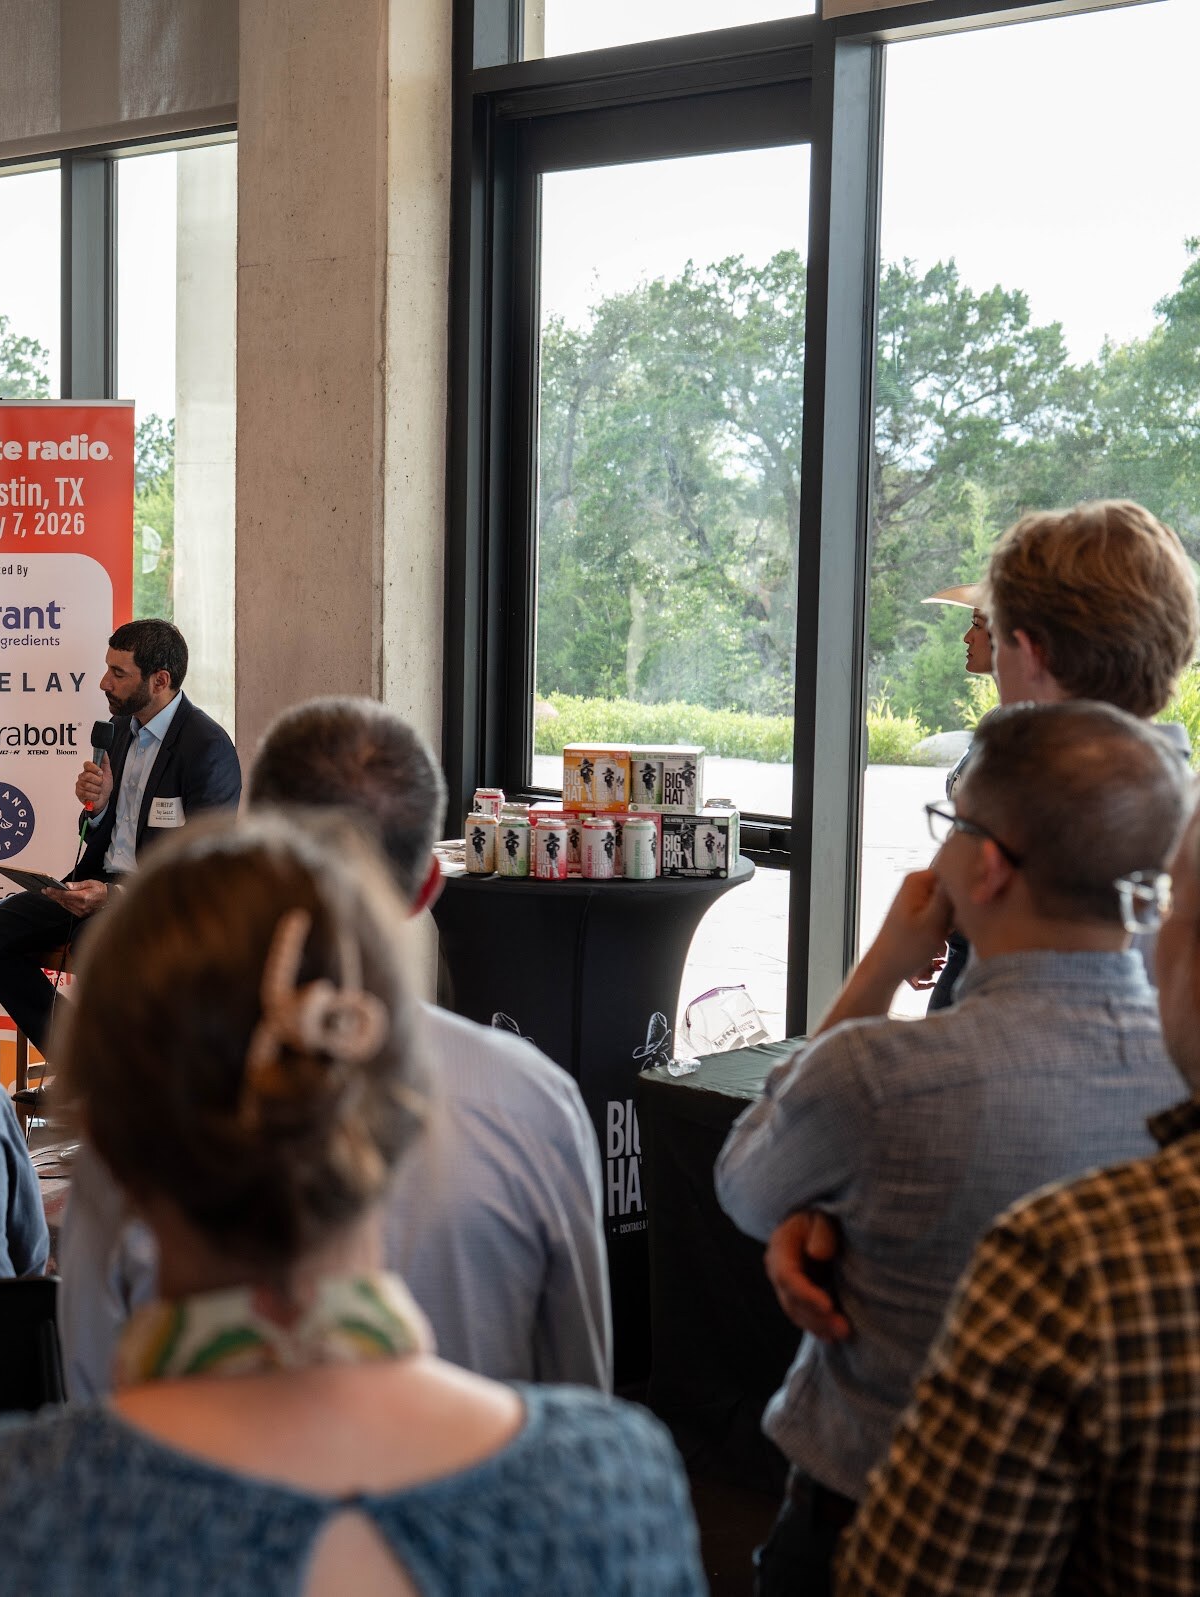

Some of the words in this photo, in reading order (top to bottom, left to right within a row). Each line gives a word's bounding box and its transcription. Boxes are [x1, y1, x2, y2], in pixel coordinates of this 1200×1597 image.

[55, 477, 84, 507] TX
[13, 512, 27, 538] 7,
[34, 512, 85, 535] 2026
[17, 565, 28, 577] By
[564, 769, 581, 786] BIG
[664, 772, 683, 789] BIG
[563, 785, 584, 802] HAT
[664, 788, 685, 805] HAT
[2, 790, 29, 838] ANGEL
[663, 834, 681, 851] BIG
[662, 851, 684, 868] HAT
